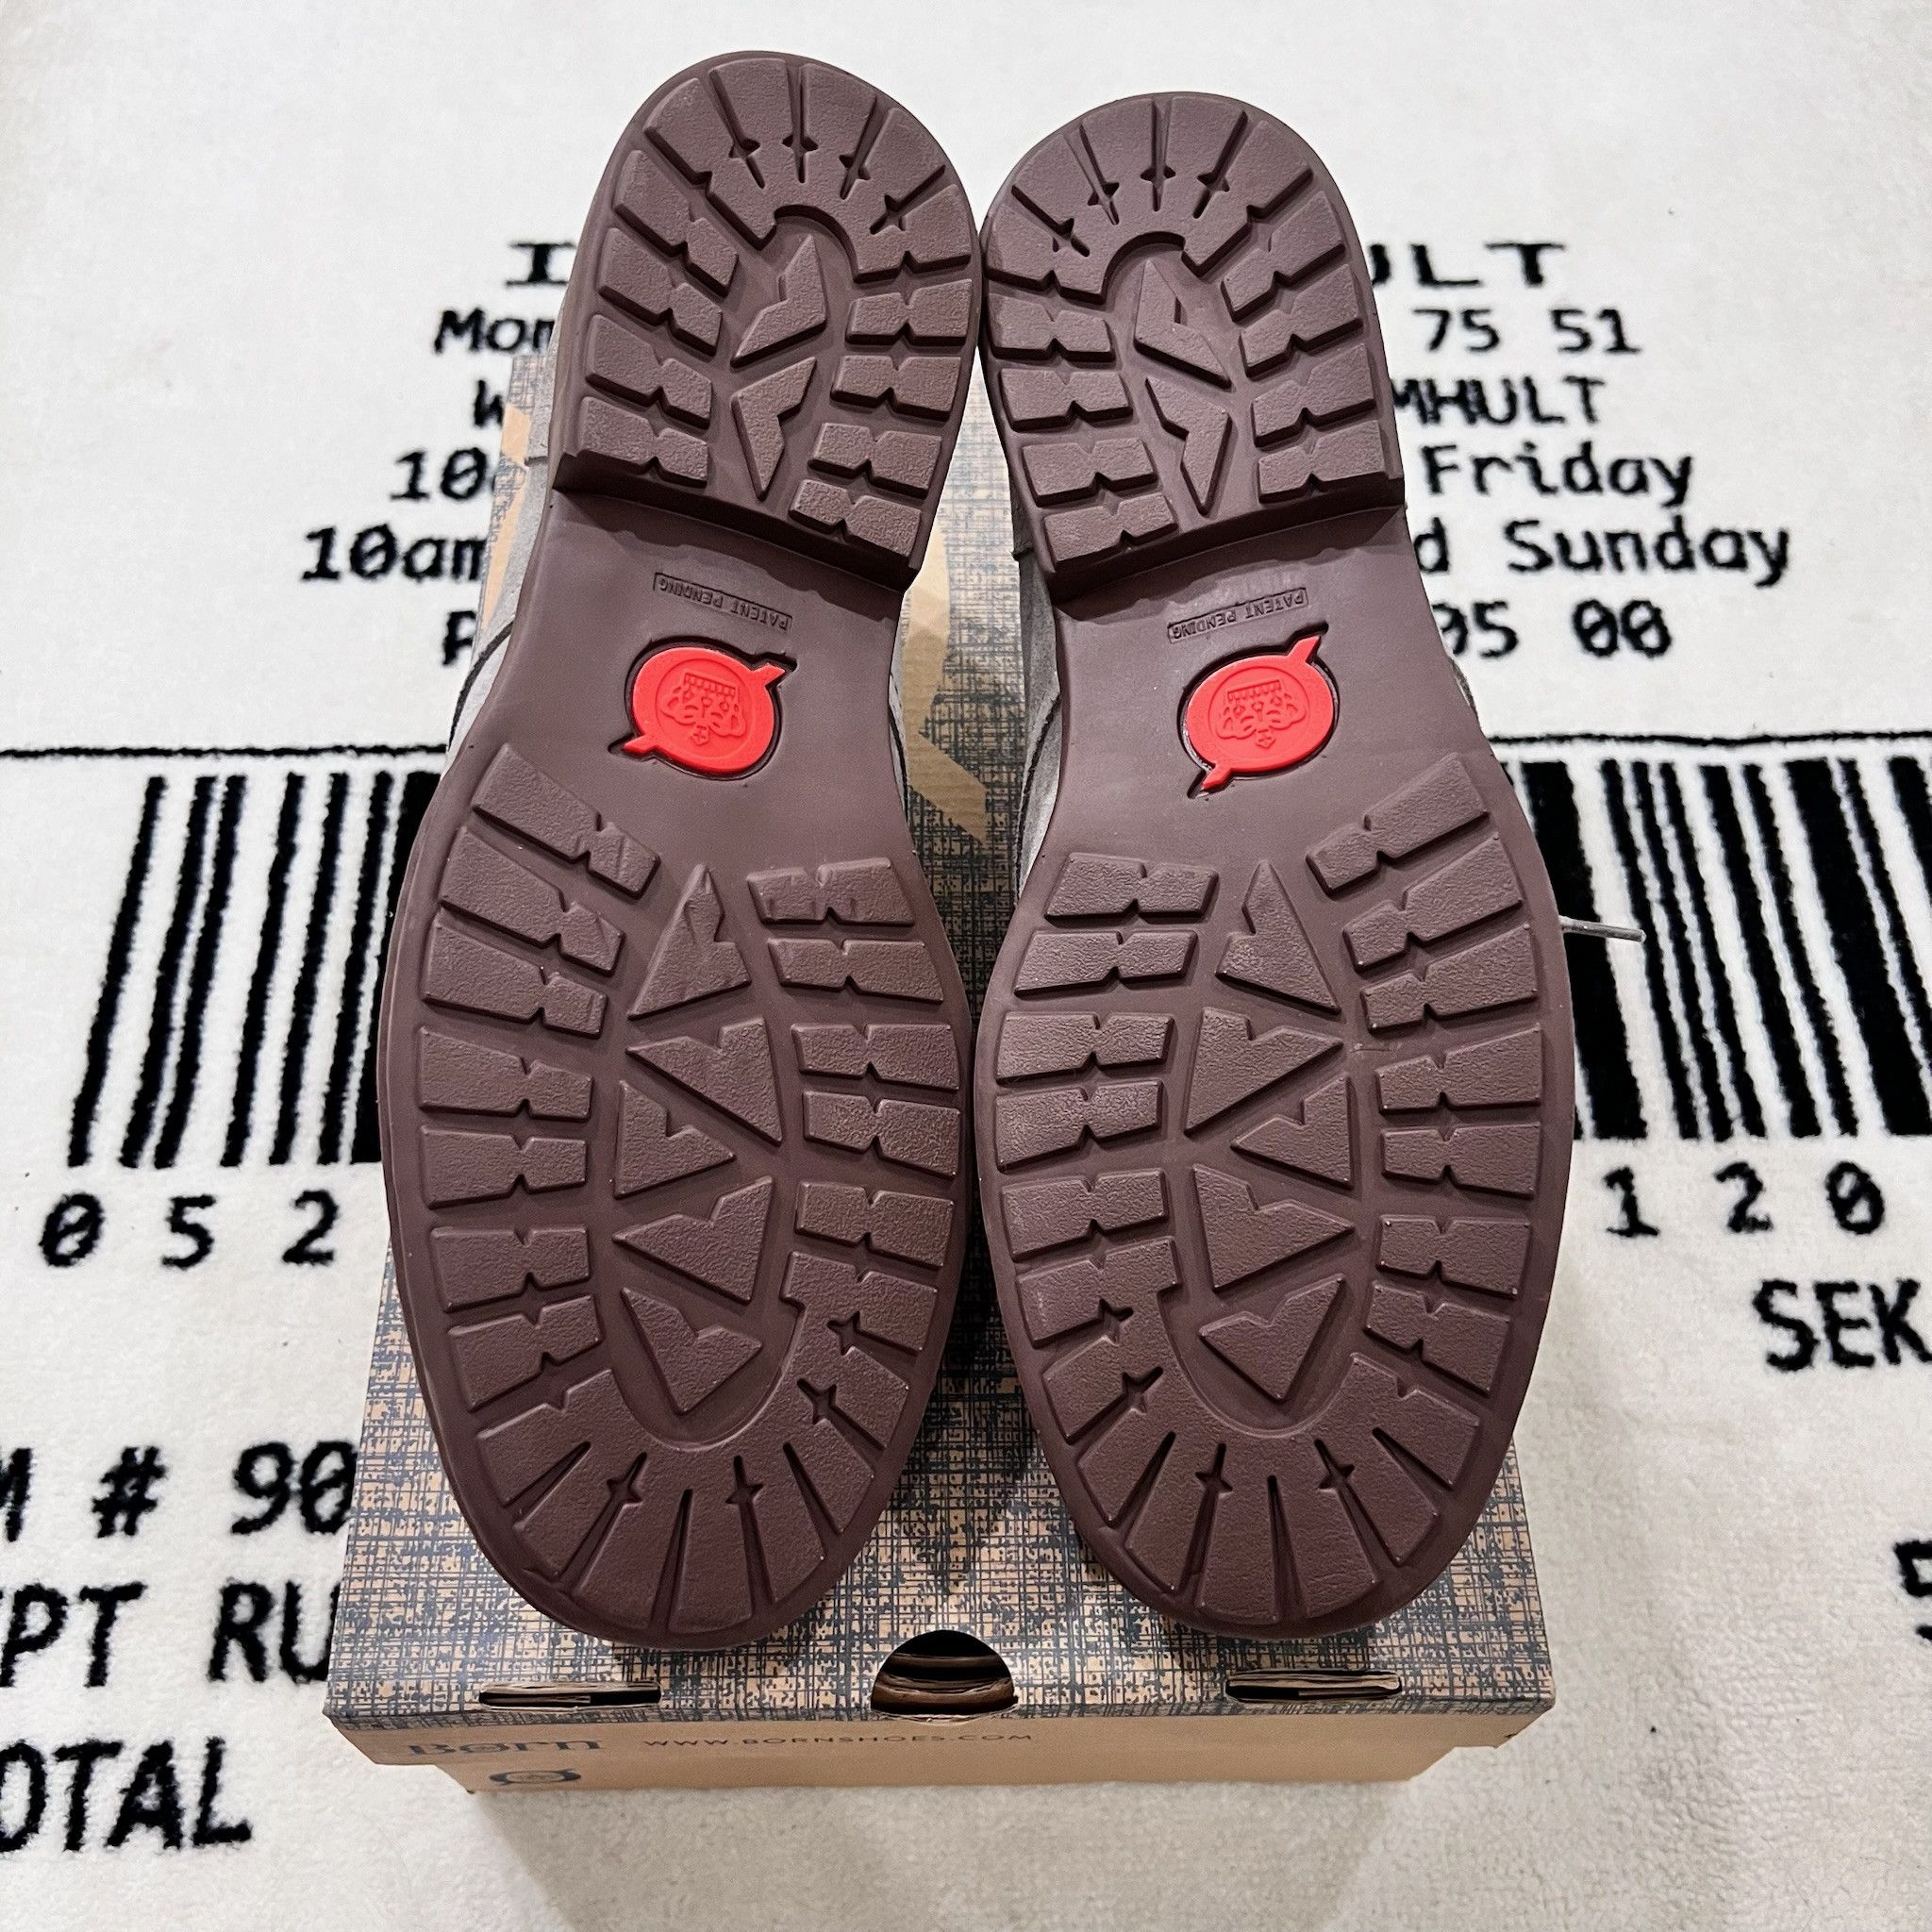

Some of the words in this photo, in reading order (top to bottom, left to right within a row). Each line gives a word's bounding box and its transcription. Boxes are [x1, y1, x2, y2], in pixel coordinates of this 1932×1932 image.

[1413, 308, 1500, 353] 75
[1549, 308, 1641, 354] 51
[1421, 441, 1692, 508] Friday
[1504, 514, 1790, 588] Sunday
[1171, 612, 1238, 640] PENDING
[1244, 588, 1306, 621] PATENT
[1572, 598, 1673, 658] 00
[1751, 1278, 1932, 1373] SEK
[642, 1734, 1033, 1747] WWW.BORNSHOES.COM
